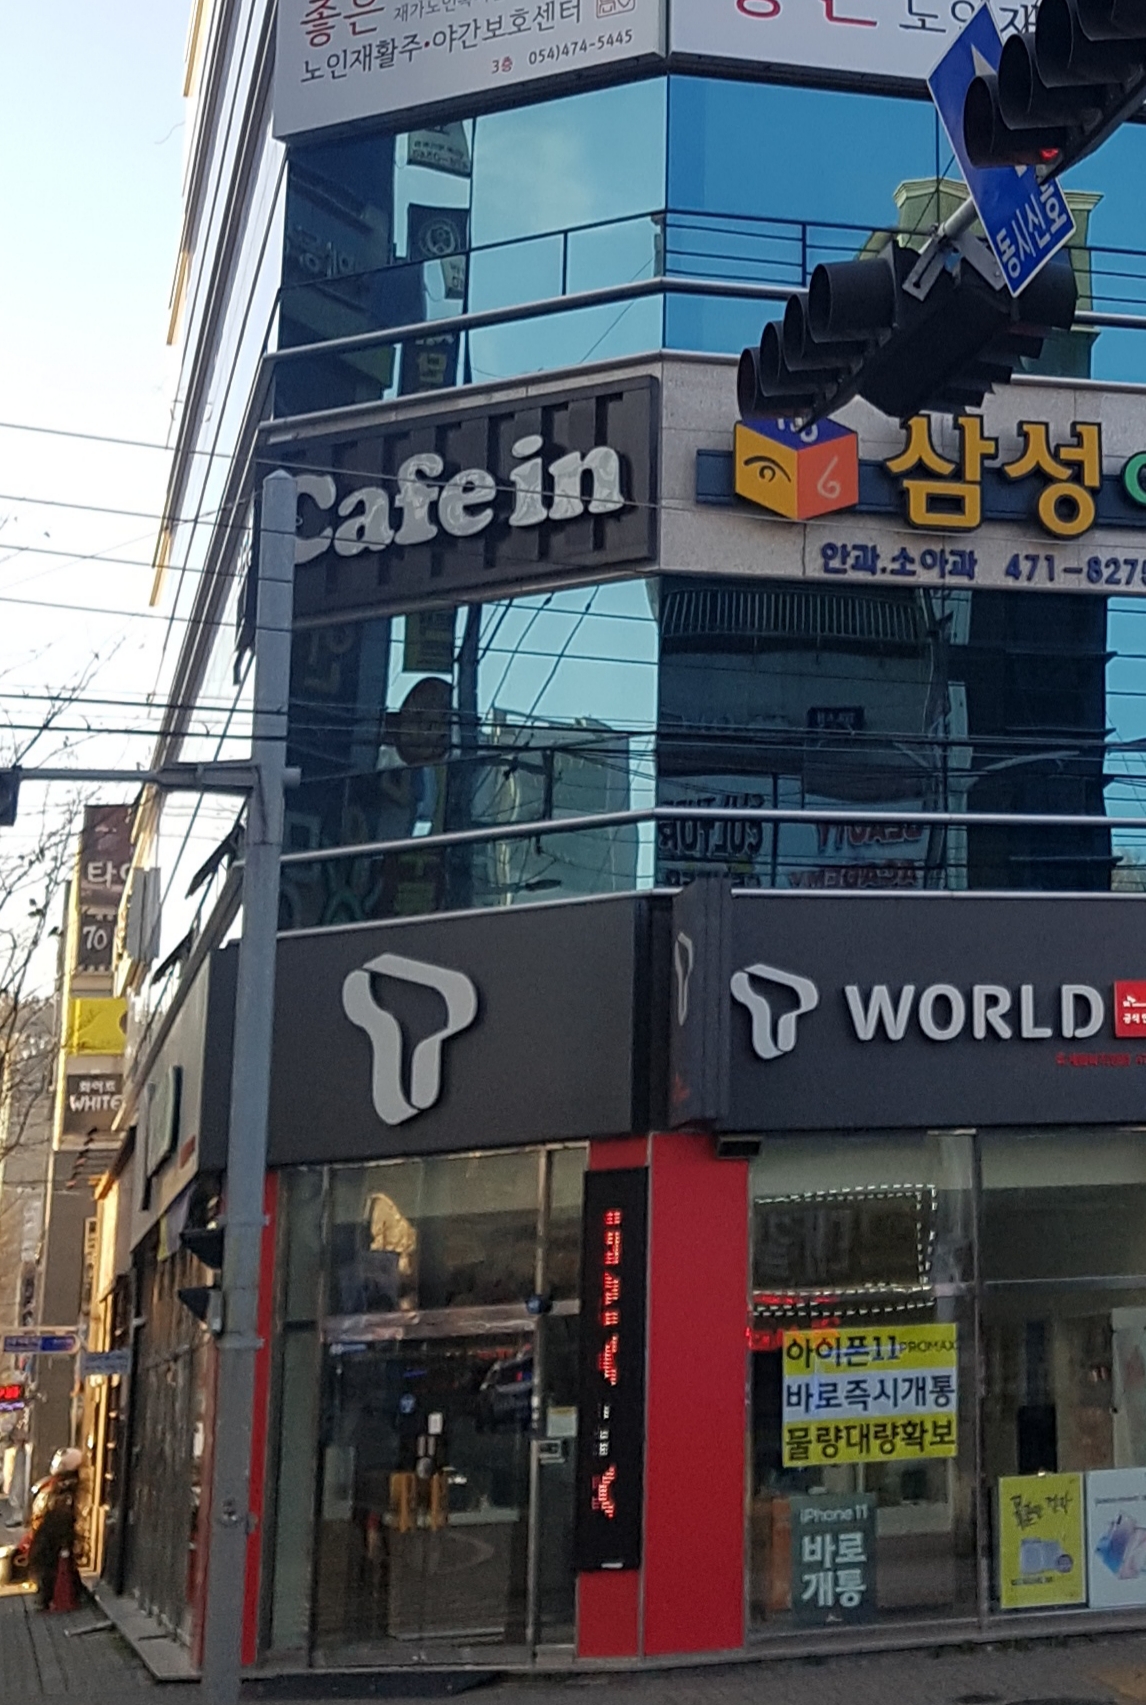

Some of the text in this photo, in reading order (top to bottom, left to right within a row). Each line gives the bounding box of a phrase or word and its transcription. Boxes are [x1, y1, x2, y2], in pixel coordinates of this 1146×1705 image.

[528, 29, 634, 67] 054)474-5445
[821, 542, 978, 581] 안과.소아과
[82, 926, 108, 950] 70
[844, 984, 1105, 1041] WORLD
[70, 1094, 123, 1113] WHITE
[786, 1374, 956, 1414] 바로즉시개통
[786, 1419, 956, 1462] 물량대량확보
[801, 1532, 868, 1569] 바로
[801, 1570, 868, 1609] 개통
